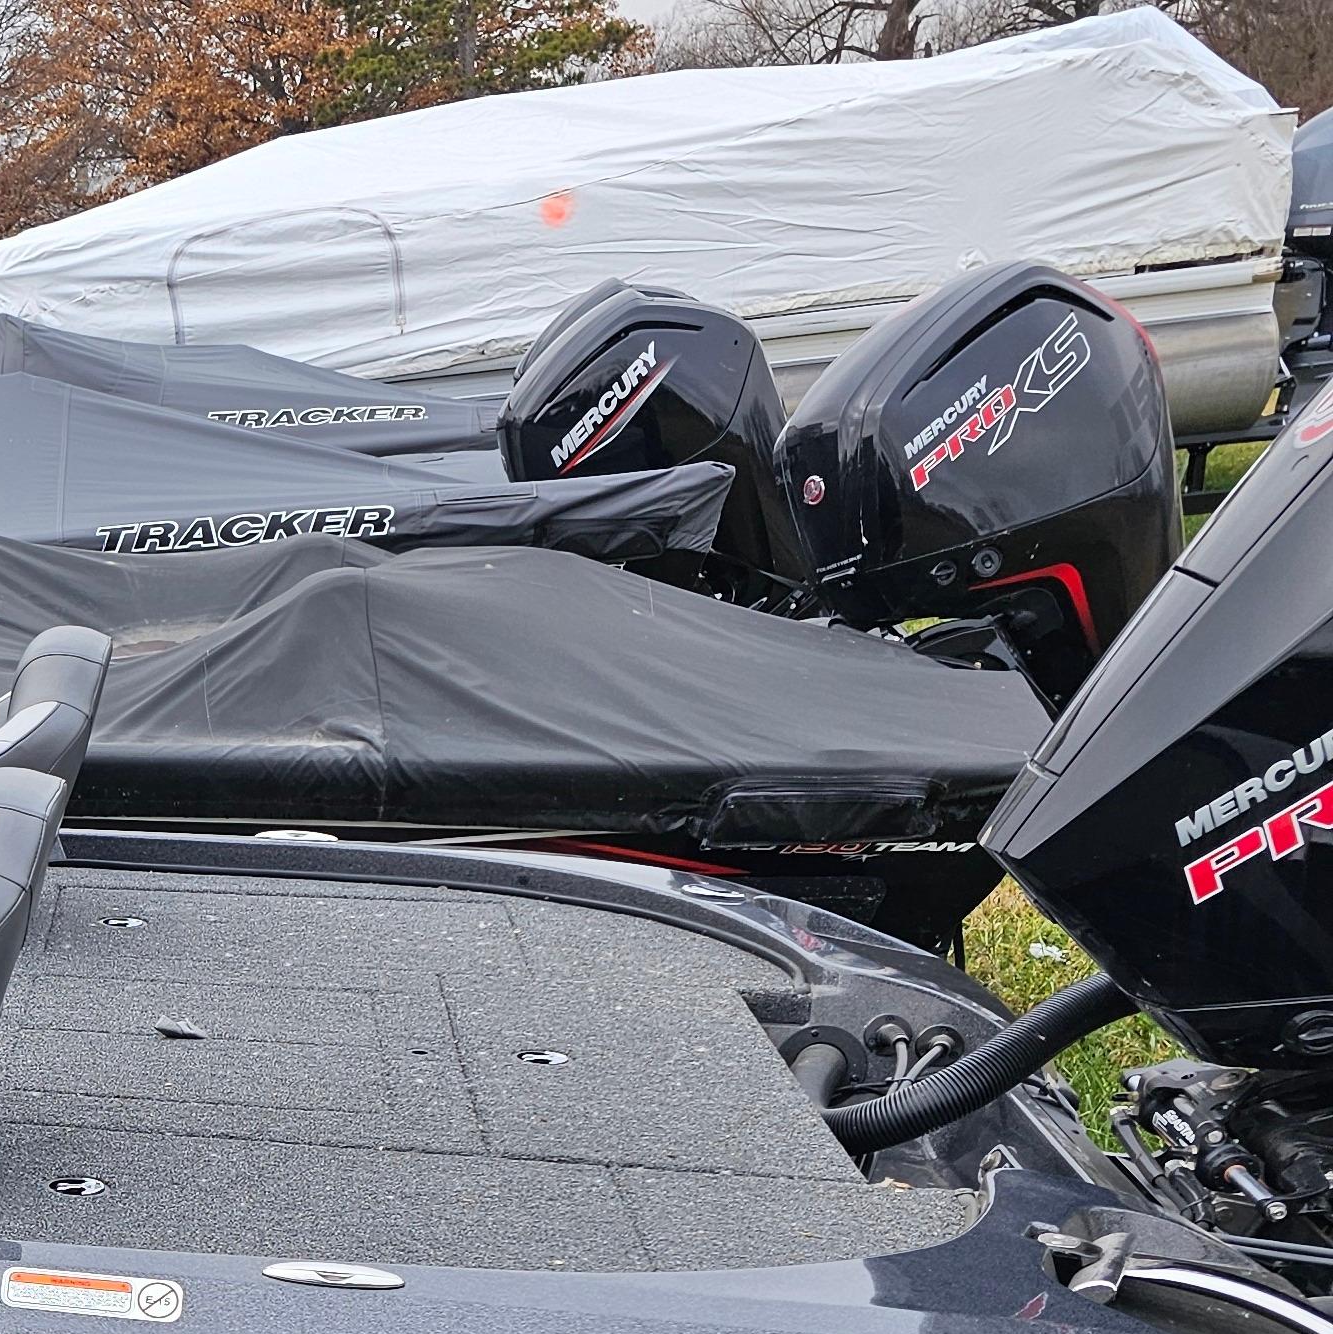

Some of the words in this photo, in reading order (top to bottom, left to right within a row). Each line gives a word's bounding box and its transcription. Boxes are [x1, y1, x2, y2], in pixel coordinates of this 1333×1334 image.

[207, 405, 426, 429] TRACKER
[550, 340, 657, 468] MERCURY
[904, 375, 988, 460] MERCURY
[96, 505, 395, 553] TRACKER
[874, 842, 975, 853] TEAM
